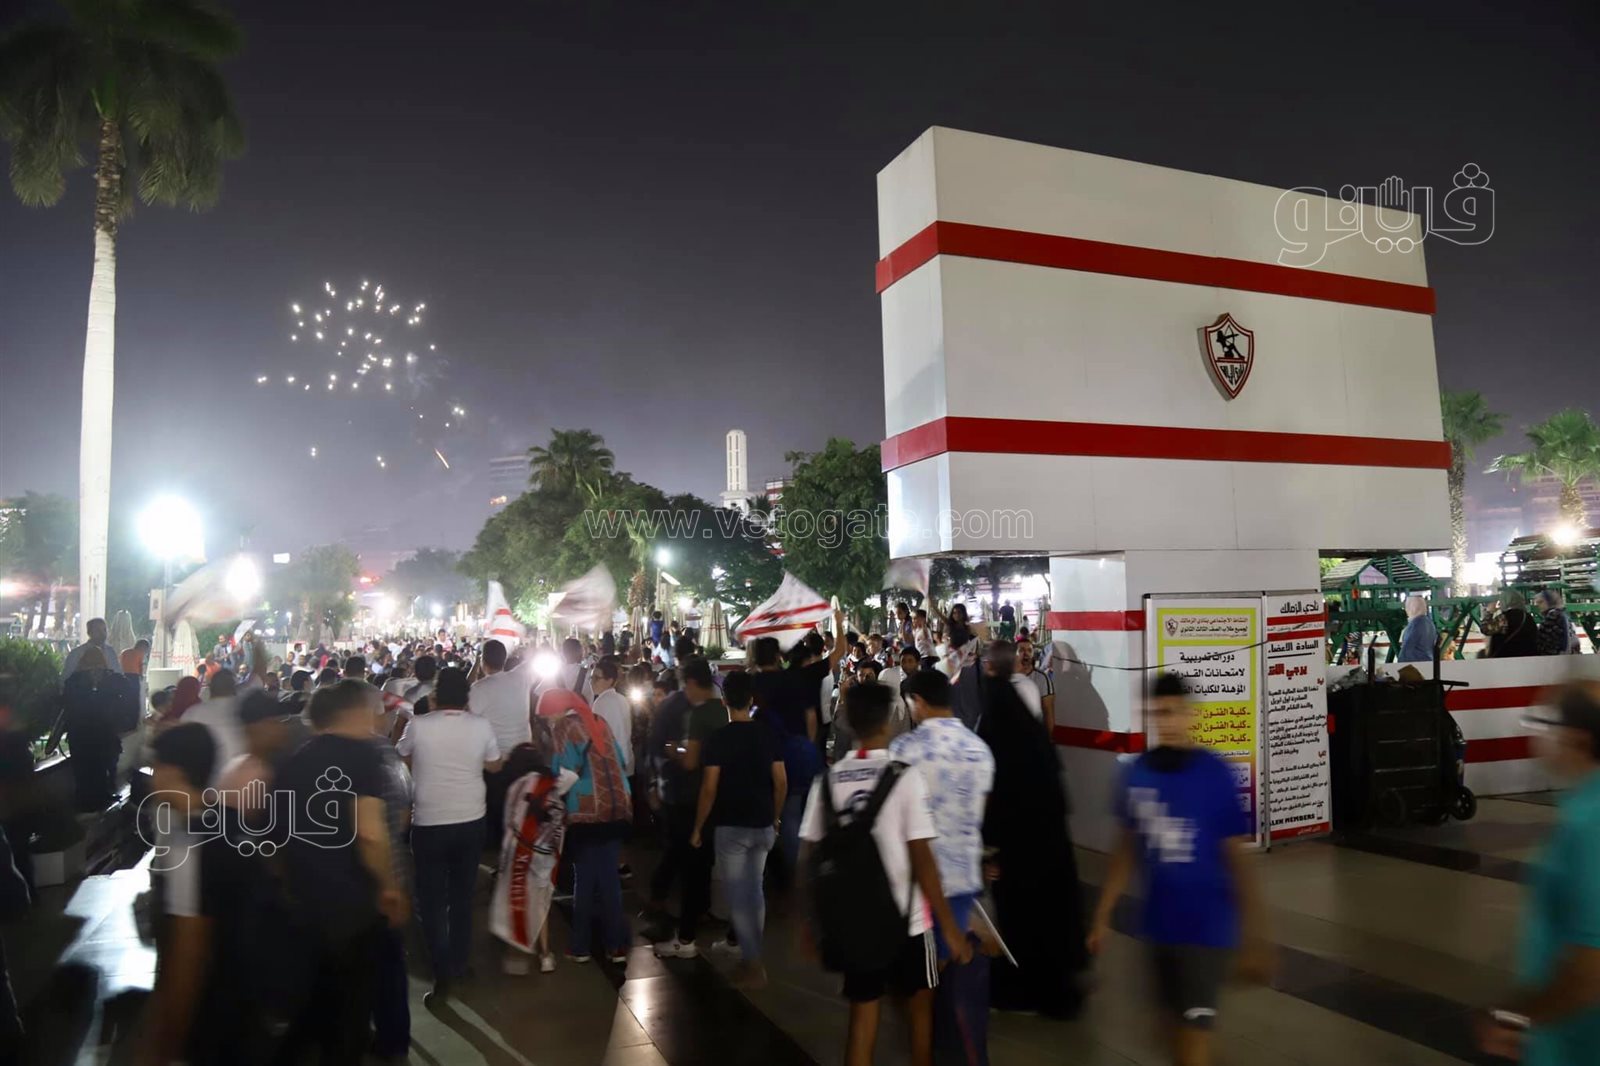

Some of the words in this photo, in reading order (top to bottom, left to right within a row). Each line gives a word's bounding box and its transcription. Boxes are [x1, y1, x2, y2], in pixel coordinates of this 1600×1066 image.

[1280, 601, 1302, 614] الزمالك
[1303, 600, 1319, 614] نادي
[1212, 652, 1235, 662] دورات
[1205, 668, 1245, 677] لامتحانات
[1194, 684, 1220, 696] للكليات
[1222, 684, 1246, 695] المؤهلة
[1203, 708, 1228, 719] الفنون
[1203, 721, 1229, 732] الفنون
[1200, 735, 1228, 746] التربية
[1285, 813, 1315, 824] MEMBERS
